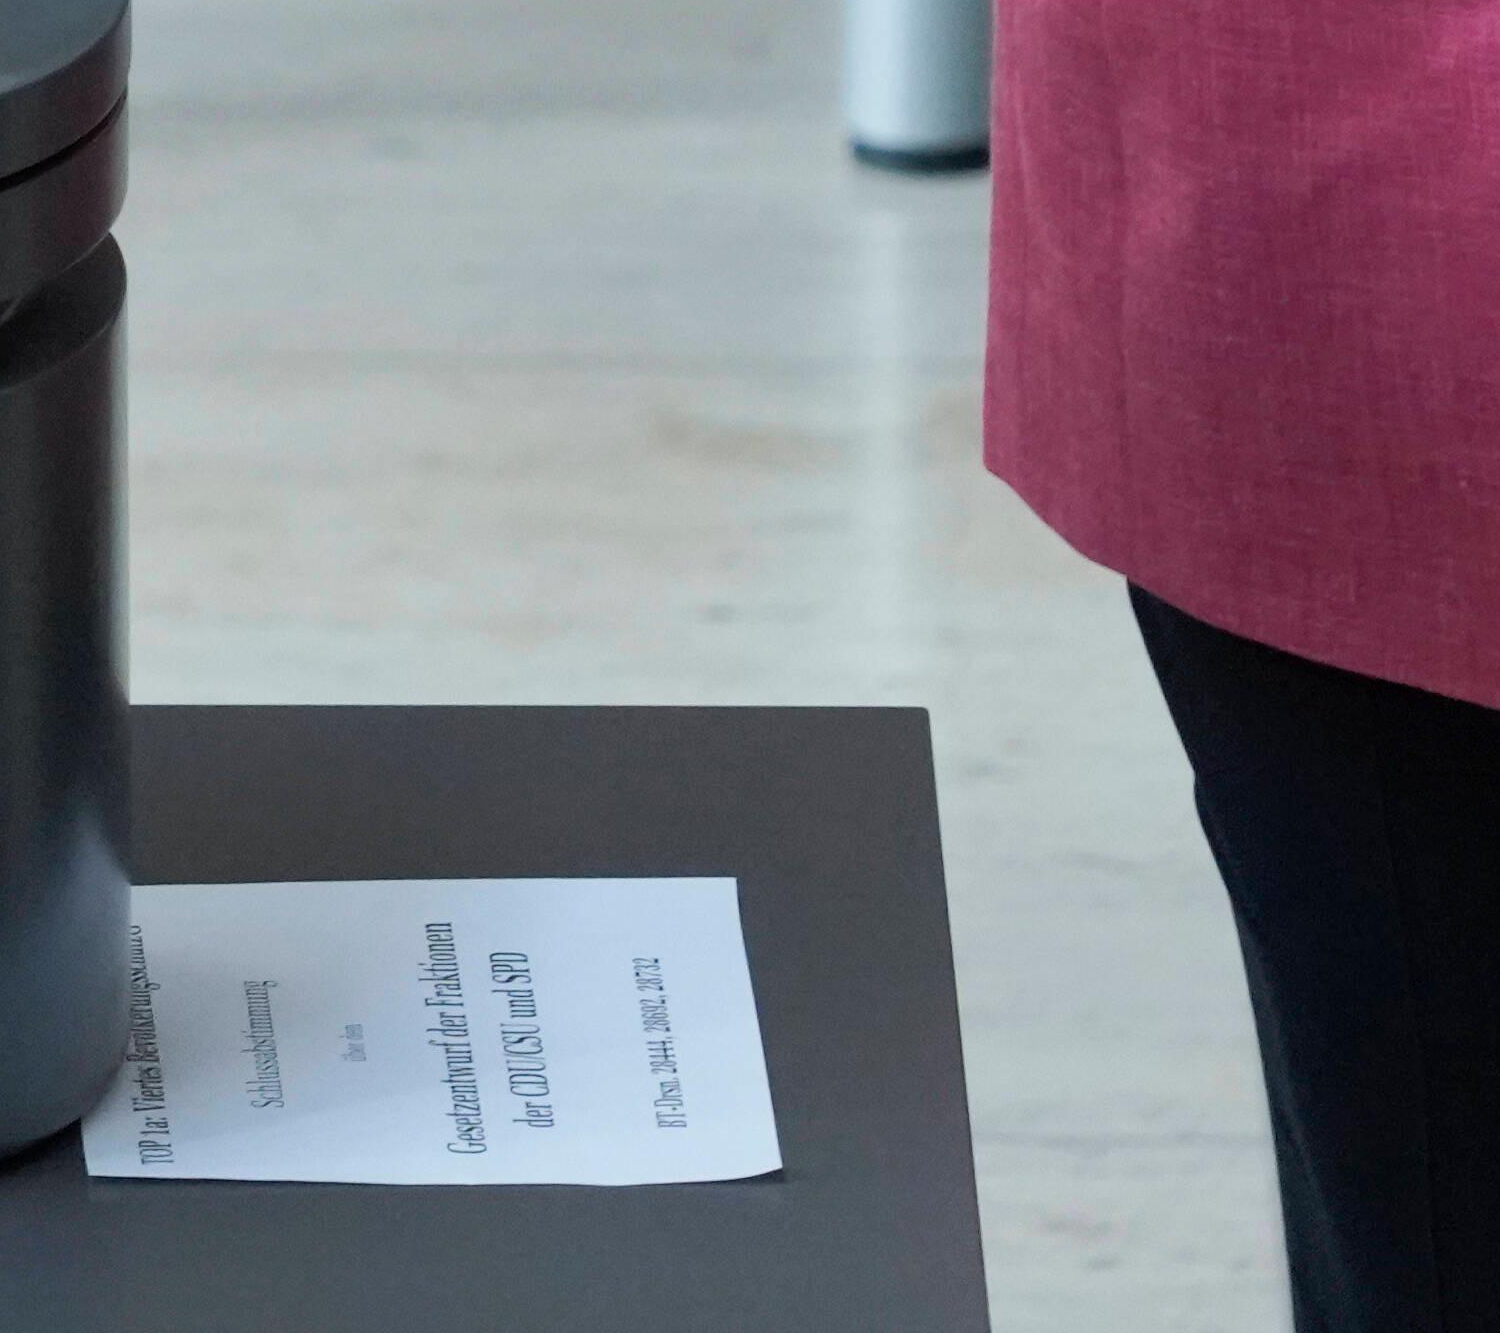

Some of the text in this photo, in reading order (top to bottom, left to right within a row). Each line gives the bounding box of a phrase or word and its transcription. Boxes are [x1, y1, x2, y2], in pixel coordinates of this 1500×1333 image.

[632, 957, 664, 992] 28732
[639, 995, 671, 1033] 28692,
[240, 980, 285, 1108] Schlussabstimmung
[417, 922, 487, 1153] Gesetzentwurf der Fraktionen
[489, 952, 555, 1127] der CDU/CSU und SPD
[646, 1035, 678, 1074] 28444,
[131, 1065, 166, 1112] Viertes
[139, 1116, 170, 1135] 1a:
[138, 1139, 174, 1166] TOP
